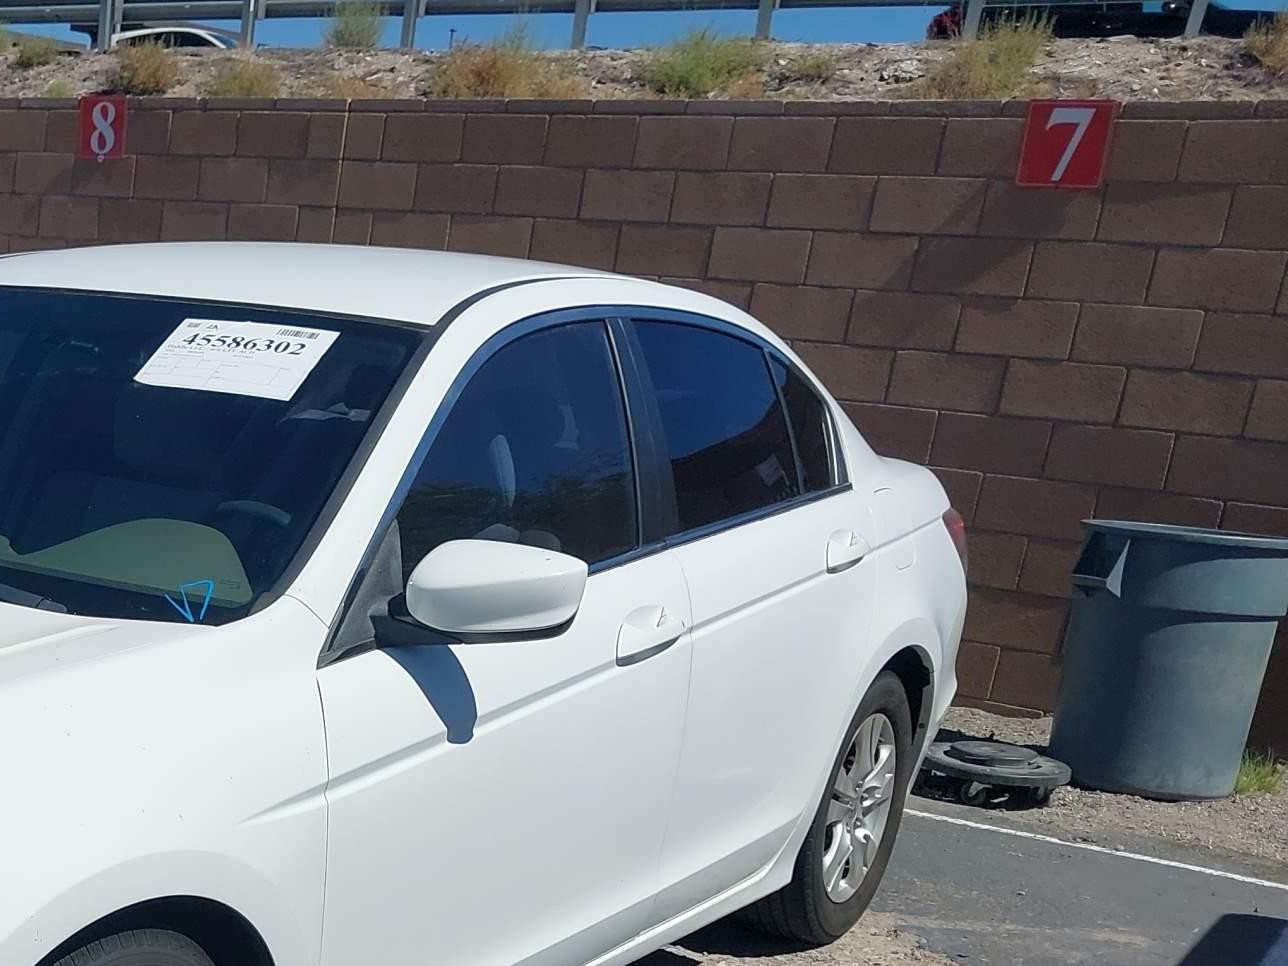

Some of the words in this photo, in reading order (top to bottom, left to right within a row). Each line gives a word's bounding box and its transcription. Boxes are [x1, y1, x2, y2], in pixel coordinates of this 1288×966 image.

[90, 102, 116, 154] 8
[1045, 108, 1097, 181] 7
[182, 332, 306, 356] 45586302
